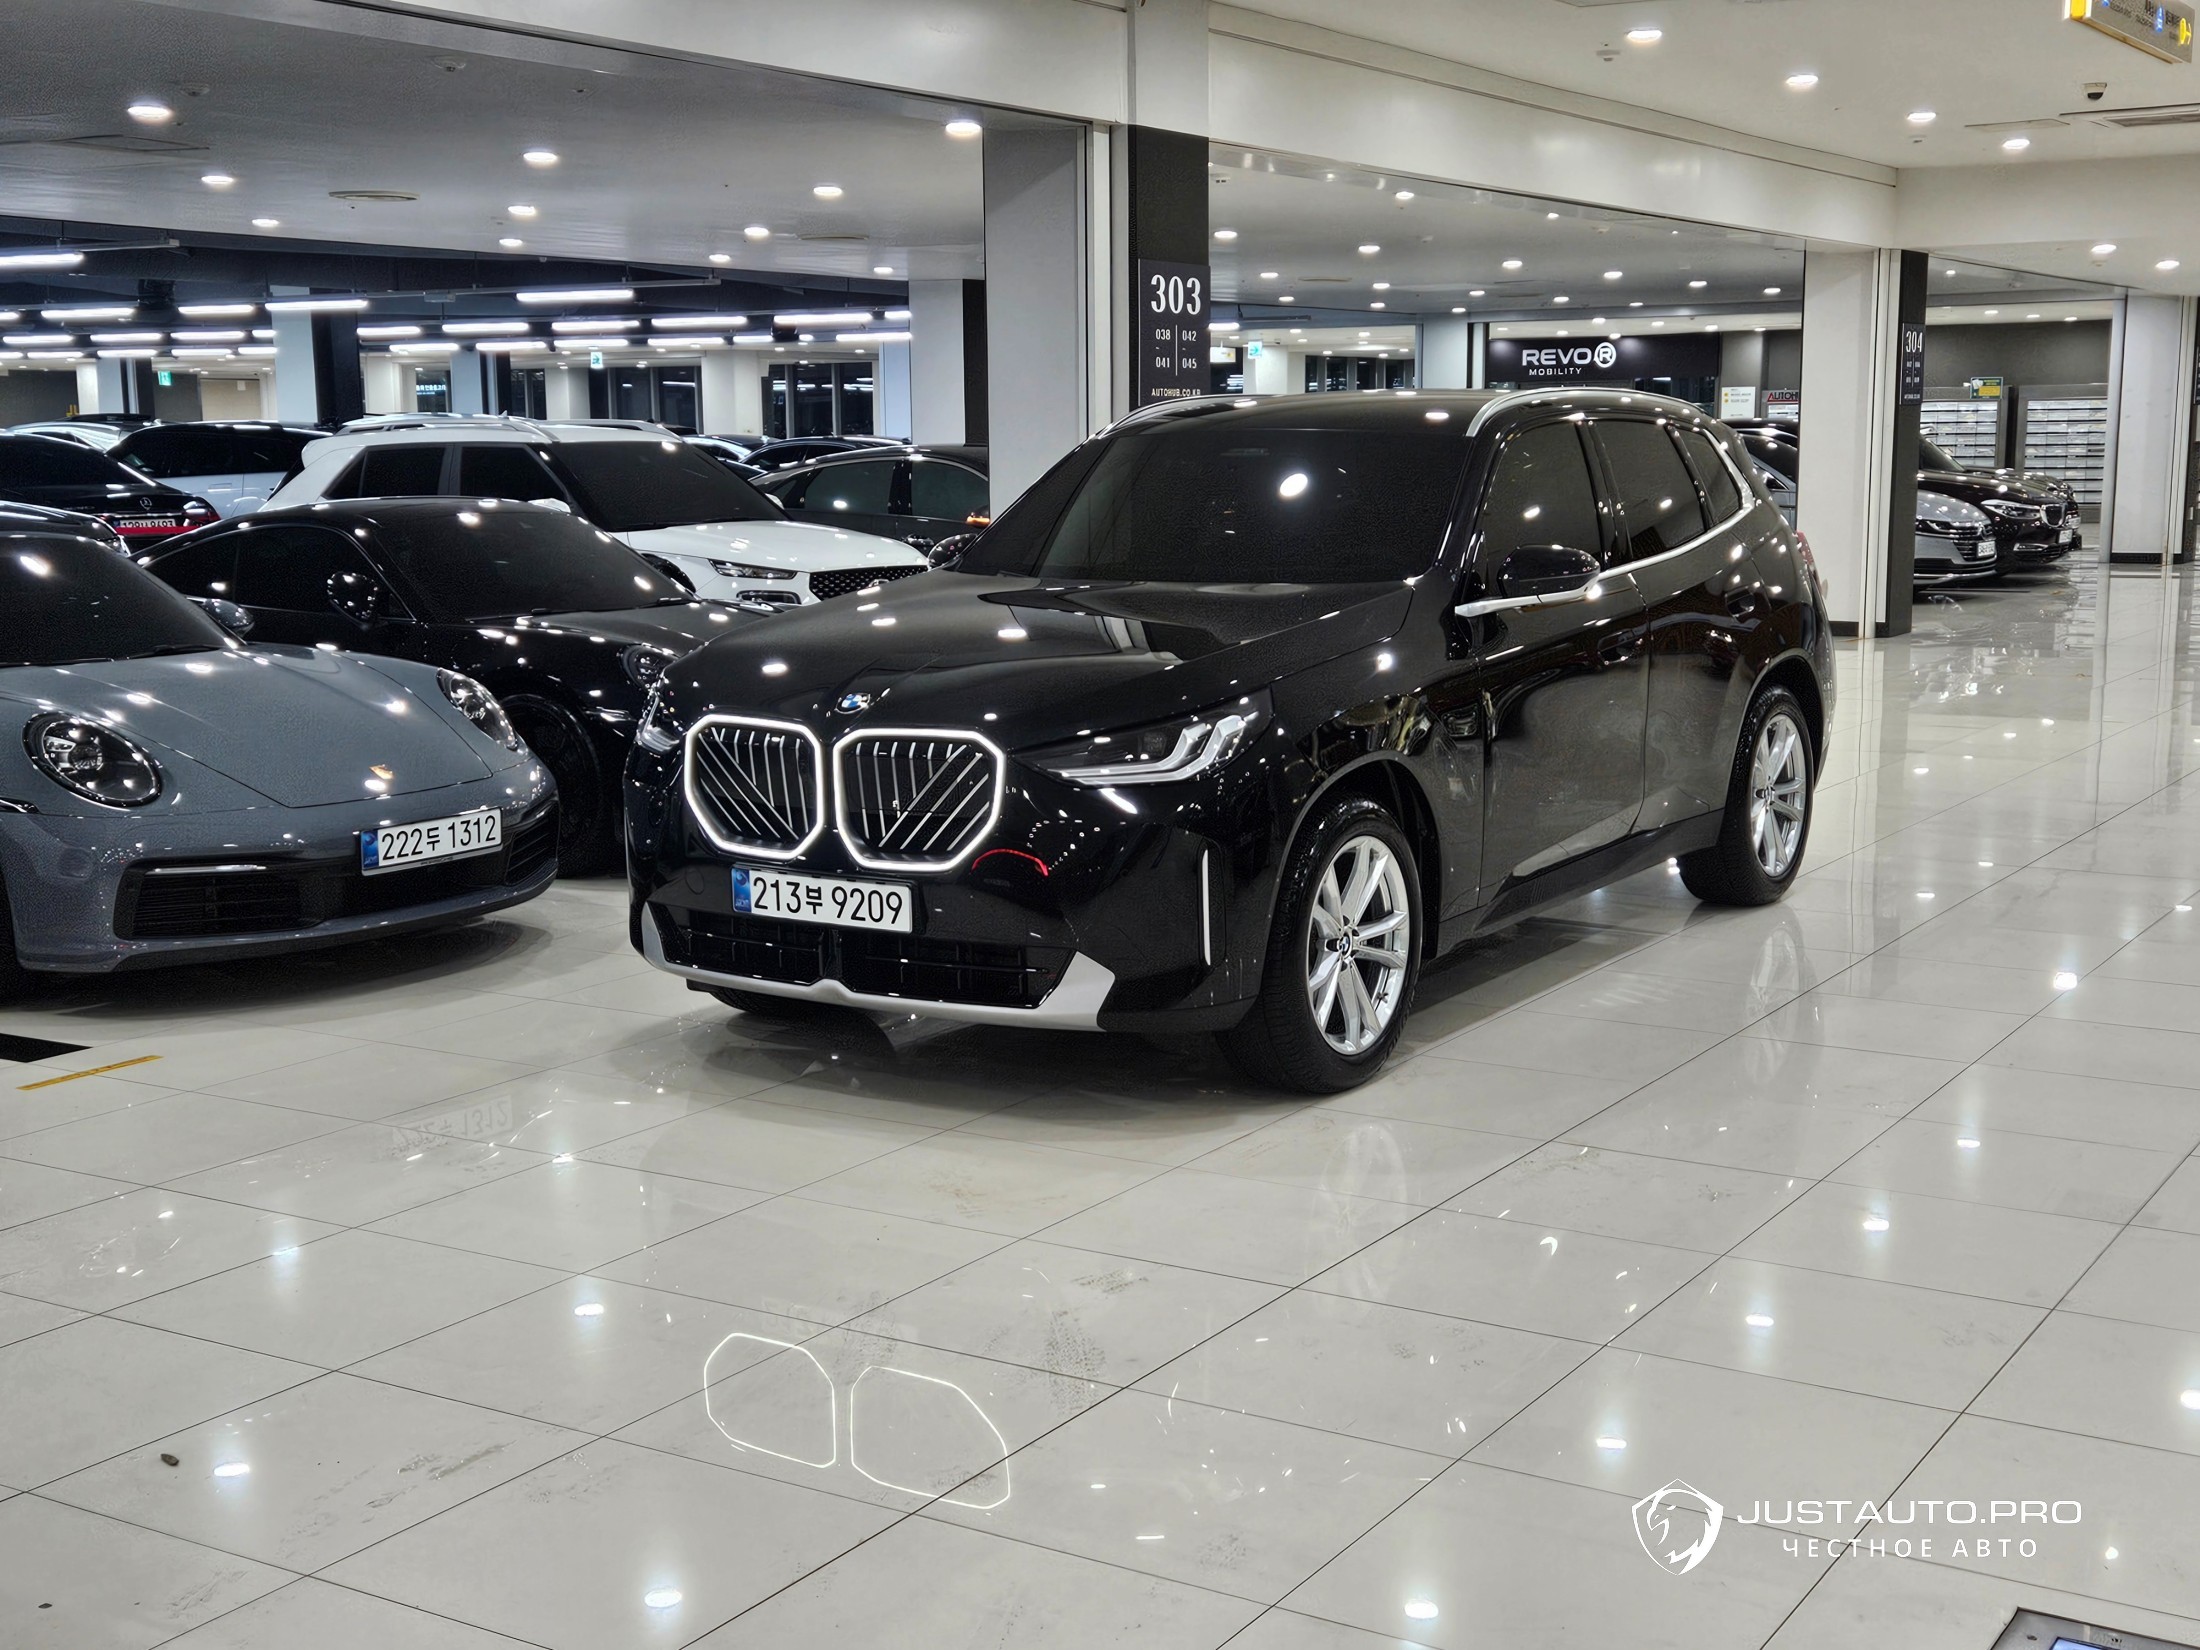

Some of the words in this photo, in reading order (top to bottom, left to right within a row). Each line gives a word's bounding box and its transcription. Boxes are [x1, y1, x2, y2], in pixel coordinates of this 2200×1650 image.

[1150, 274, 1201, 316] 303
[1155, 328, 1171, 341] 038
[1182, 330, 1197, 342] 042
[1905, 330, 1923, 353] 304
[1155, 356, 1170, 368] 041
[1182, 357, 1197, 369] 045
[1528, 367, 1582, 376] MOBILITY
[381, 827, 441, 861] 222두
[447, 814, 497, 849] 1312
[753, 876, 824, 915] 213부
[831, 885, 904, 925] 9209
